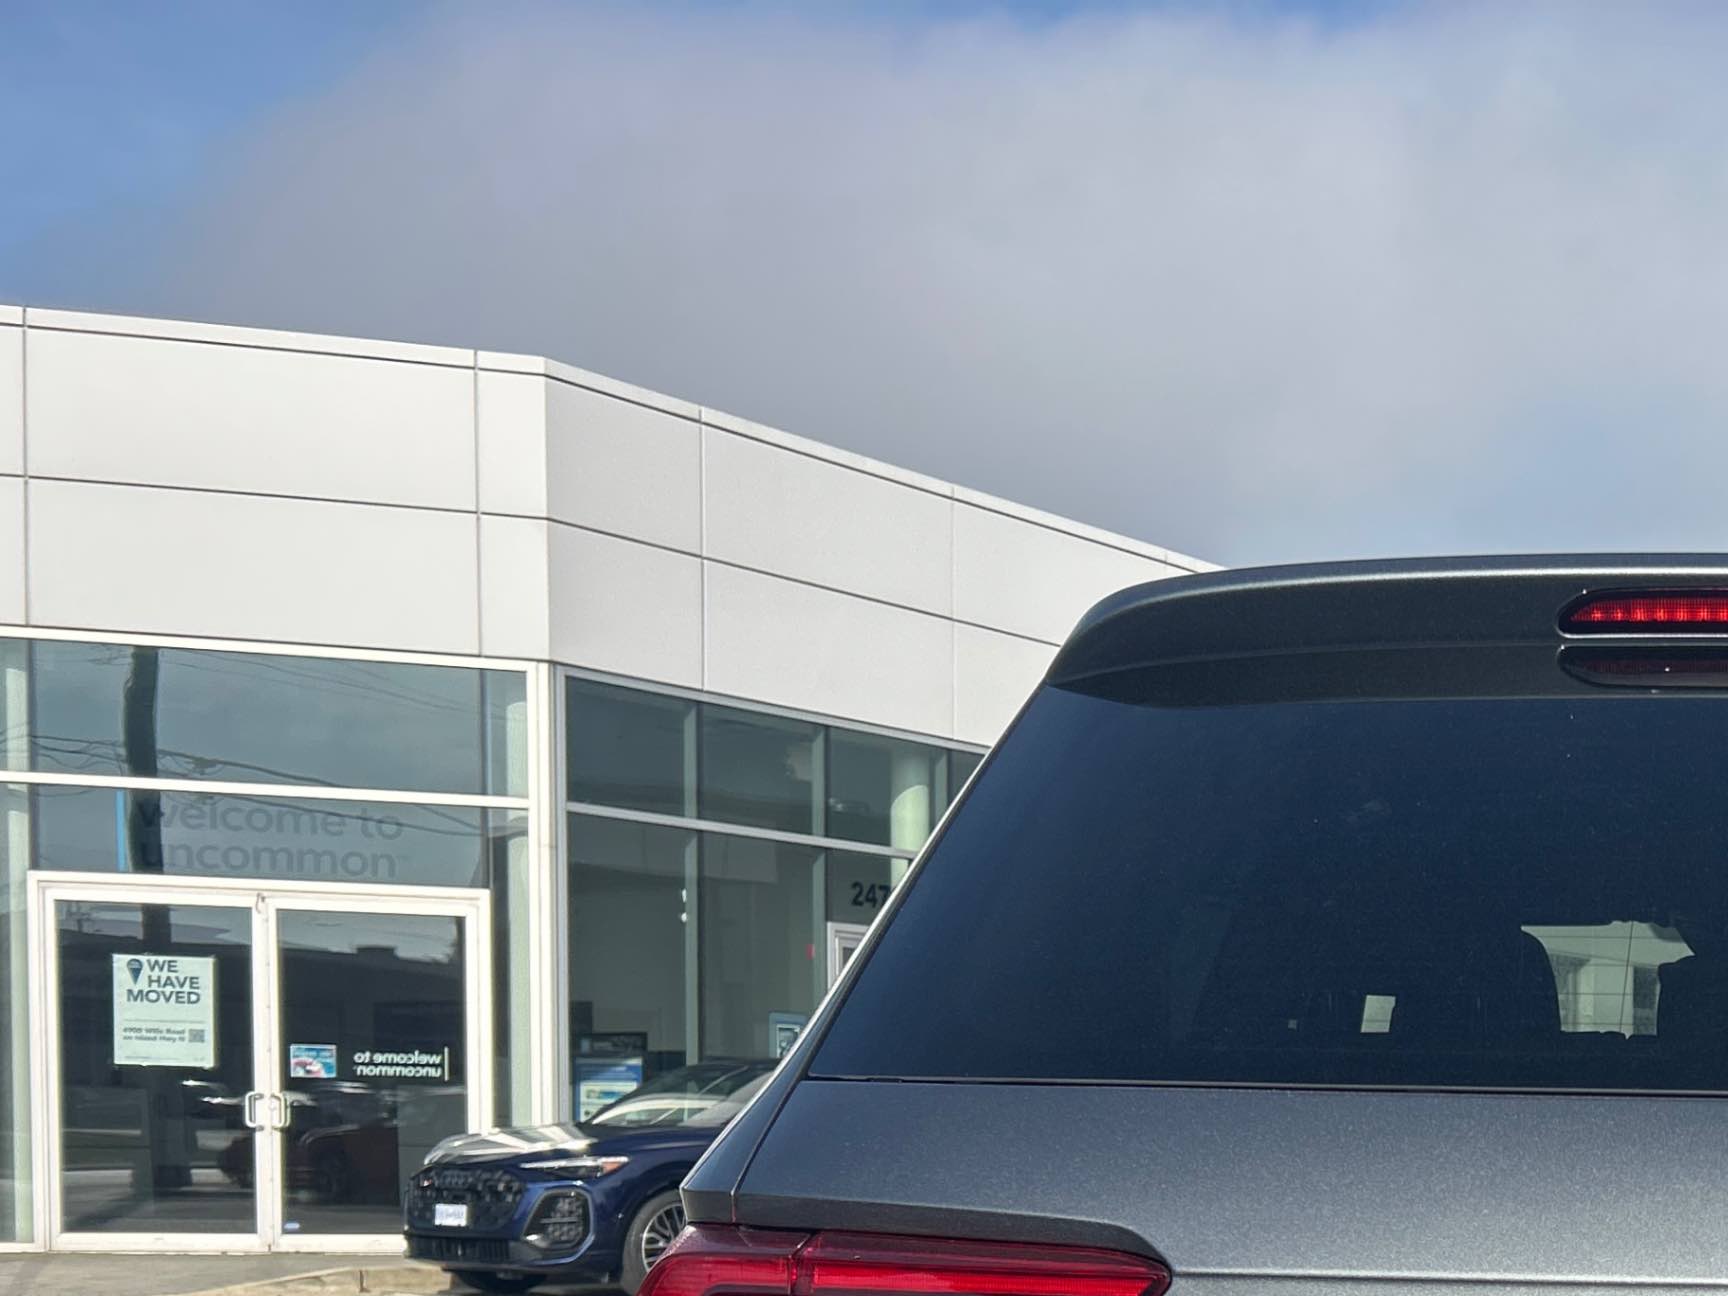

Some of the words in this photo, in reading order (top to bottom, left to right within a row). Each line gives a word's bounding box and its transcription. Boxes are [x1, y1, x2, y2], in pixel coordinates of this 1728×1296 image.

[137, 800, 347, 837] welcome
[360, 808, 403, 840] to
[140, 842, 397, 878] uncommon
[147, 959, 179, 973] WE
[147, 975, 201, 990] HAVE
[126, 989, 201, 1005] MOVED
